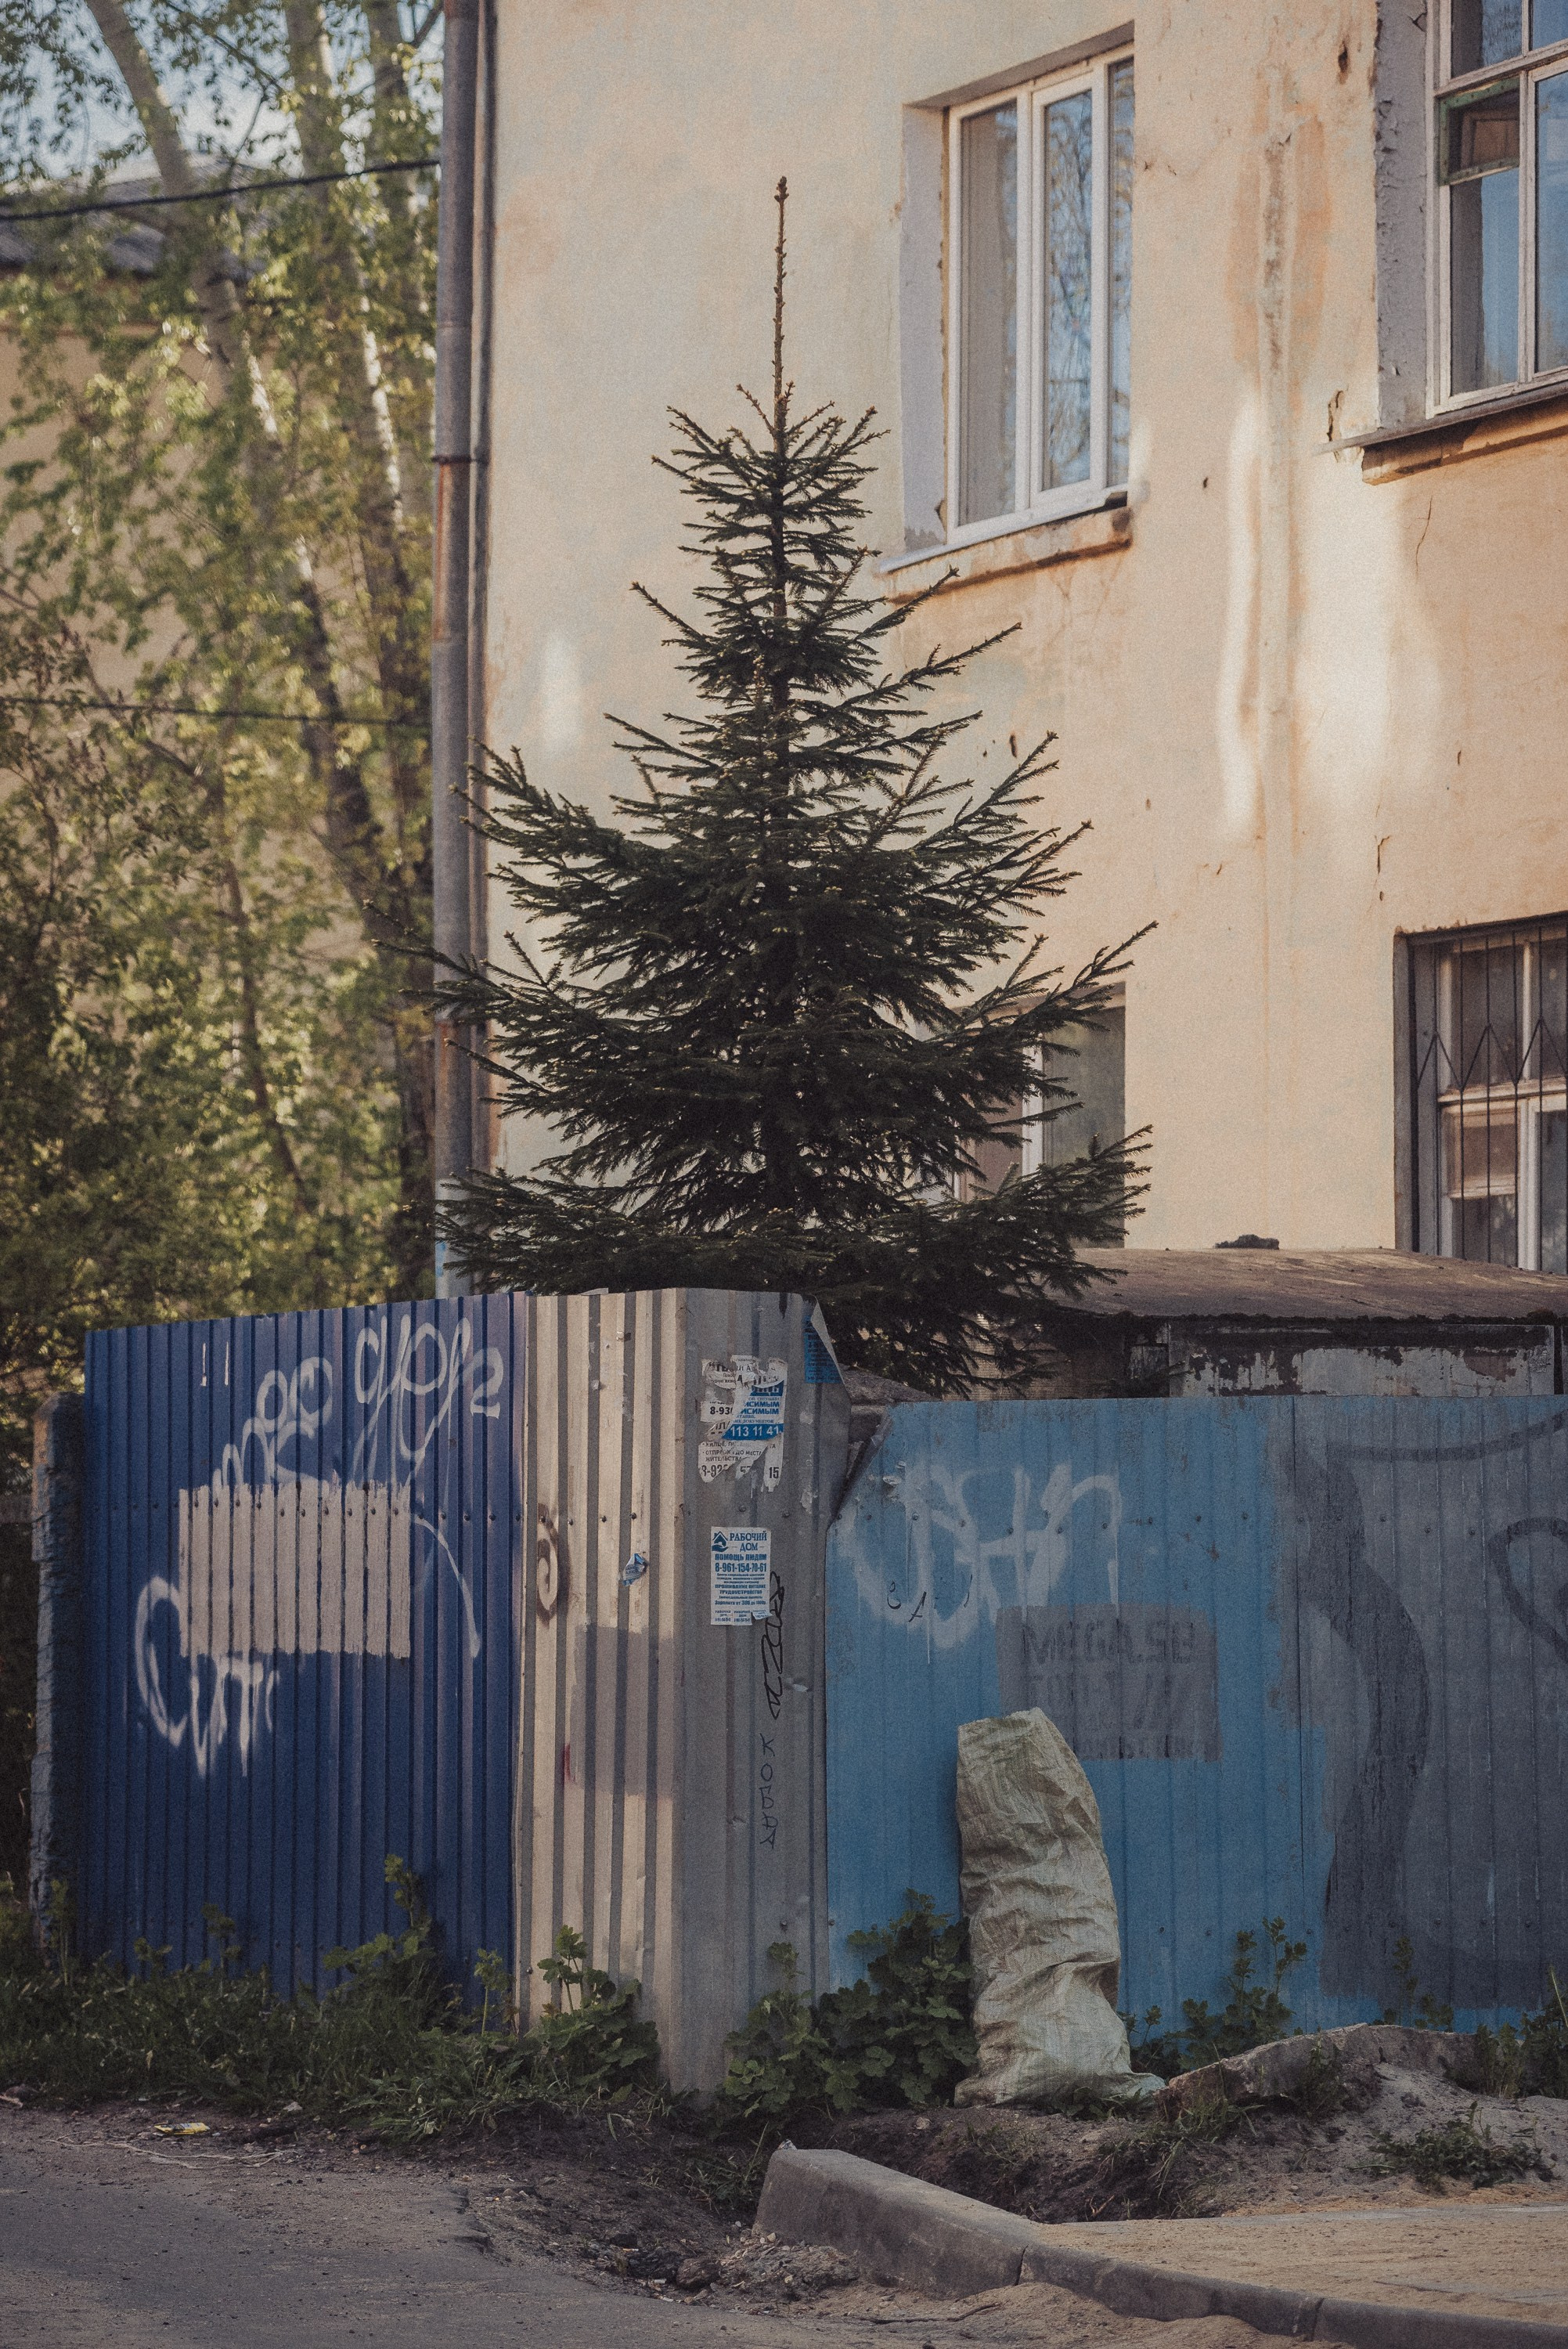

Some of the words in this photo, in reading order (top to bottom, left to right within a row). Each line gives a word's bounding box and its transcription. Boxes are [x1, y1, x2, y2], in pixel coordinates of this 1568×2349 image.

[730, 1426, 749, 1437] 113
[752, 1425, 762, 1437] 11
[769, 1467, 779, 1478] 15
[730, 1531, 767, 1542] РАБОЧИЙ
[740, 1543, 759, 1552] ДОМ
[715, 1563, 767, 1572] 8-961-154-70-61
